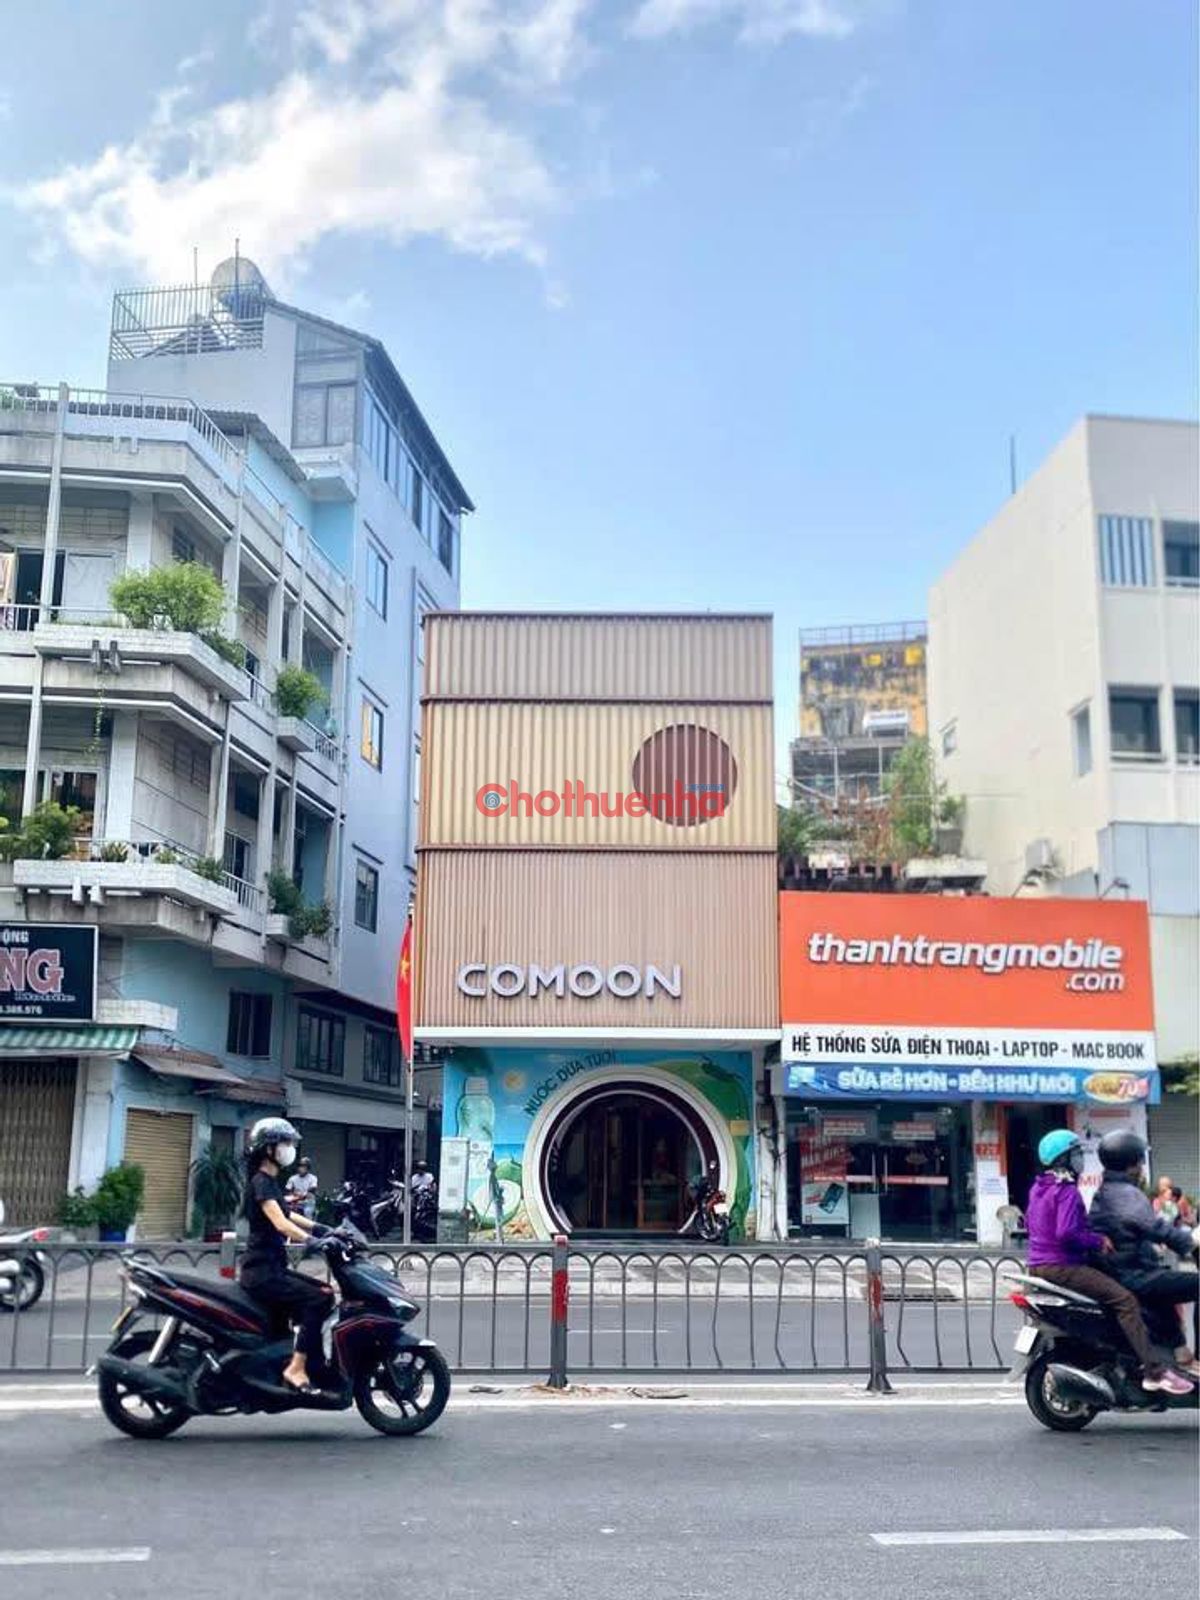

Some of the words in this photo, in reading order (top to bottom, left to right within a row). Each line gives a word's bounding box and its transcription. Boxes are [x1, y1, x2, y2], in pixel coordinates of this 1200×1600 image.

[0, 928, 29, 945] ỘNG
[808, 932, 1123, 973] thanhtrangmobile
[457, 963, 683, 999] COMOON
[1066, 971, 1125, 992] .com
[792, 1032, 811, 1056] HỆ
[816, 1030, 866, 1053] THỐNG
[871, 1030, 902, 1054] SỬA
[907, 1034, 942, 1059] ĐIỆN
[946, 1039, 990, 1060] THOẠI
[1002, 1041, 1059, 1057] LAPTOP
[1072, 1042, 1104, 1059] MAC
[1106, 1043, 1144, 1059] BOOK
